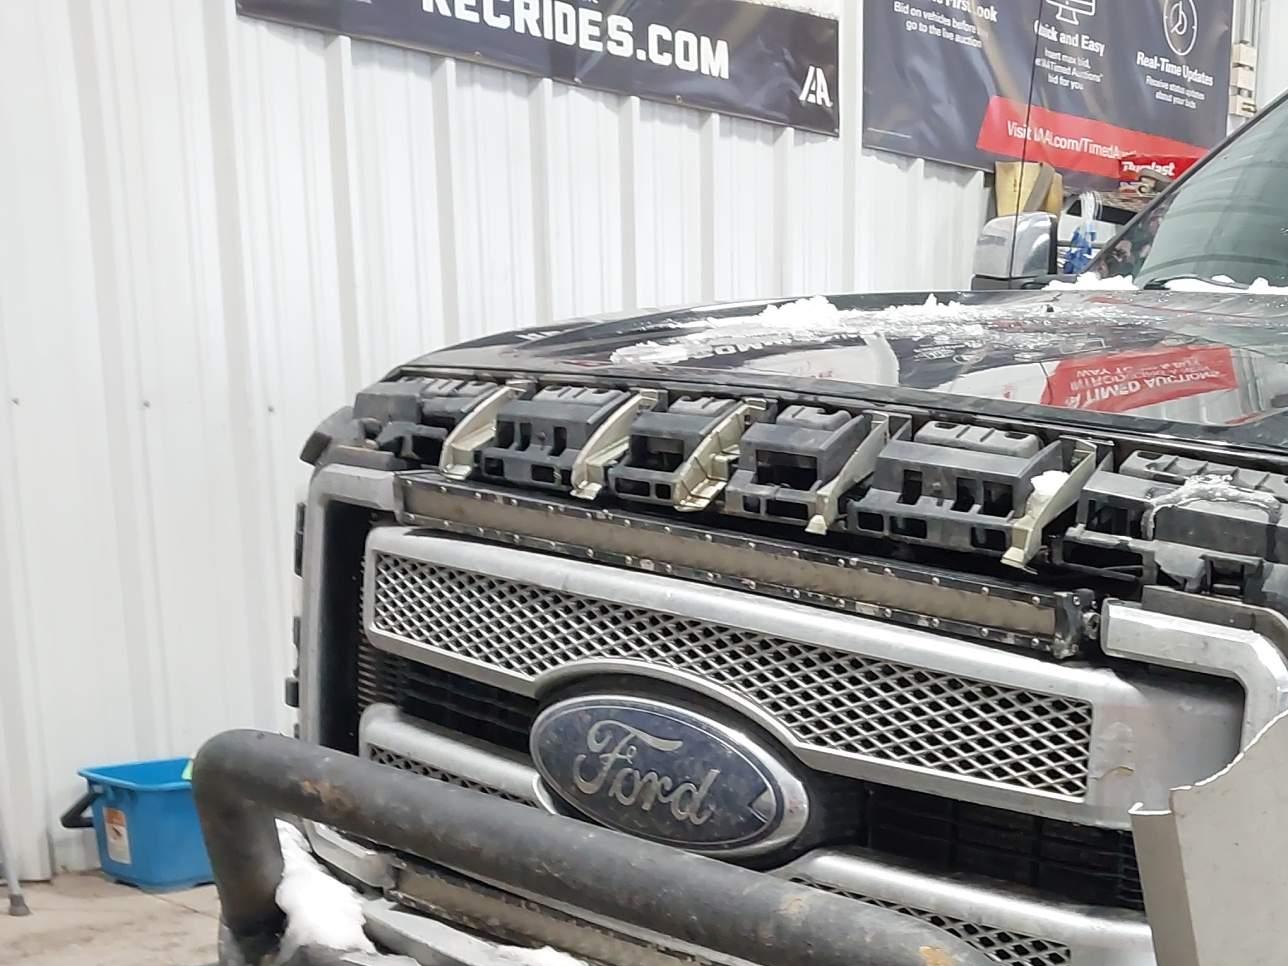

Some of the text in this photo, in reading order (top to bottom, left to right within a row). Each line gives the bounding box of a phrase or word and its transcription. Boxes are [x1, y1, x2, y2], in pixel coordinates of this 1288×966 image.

[893, 1, 909, 14] Bid
[910, 7, 922, 17] on
[923, 10, 951, 26] vehicles
[905, 20, 918, 31] go
[918, 22, 928, 33] to
[929, 25, 941, 36] the
[1059, 32, 1079, 47] and
[1081, 34, 1105, 56] Easy
[1137, 51, 1213, 86] Real-Time Updates
[1007, 121, 1032, 140] Visit
[573, 720, 720, 825] Ford
